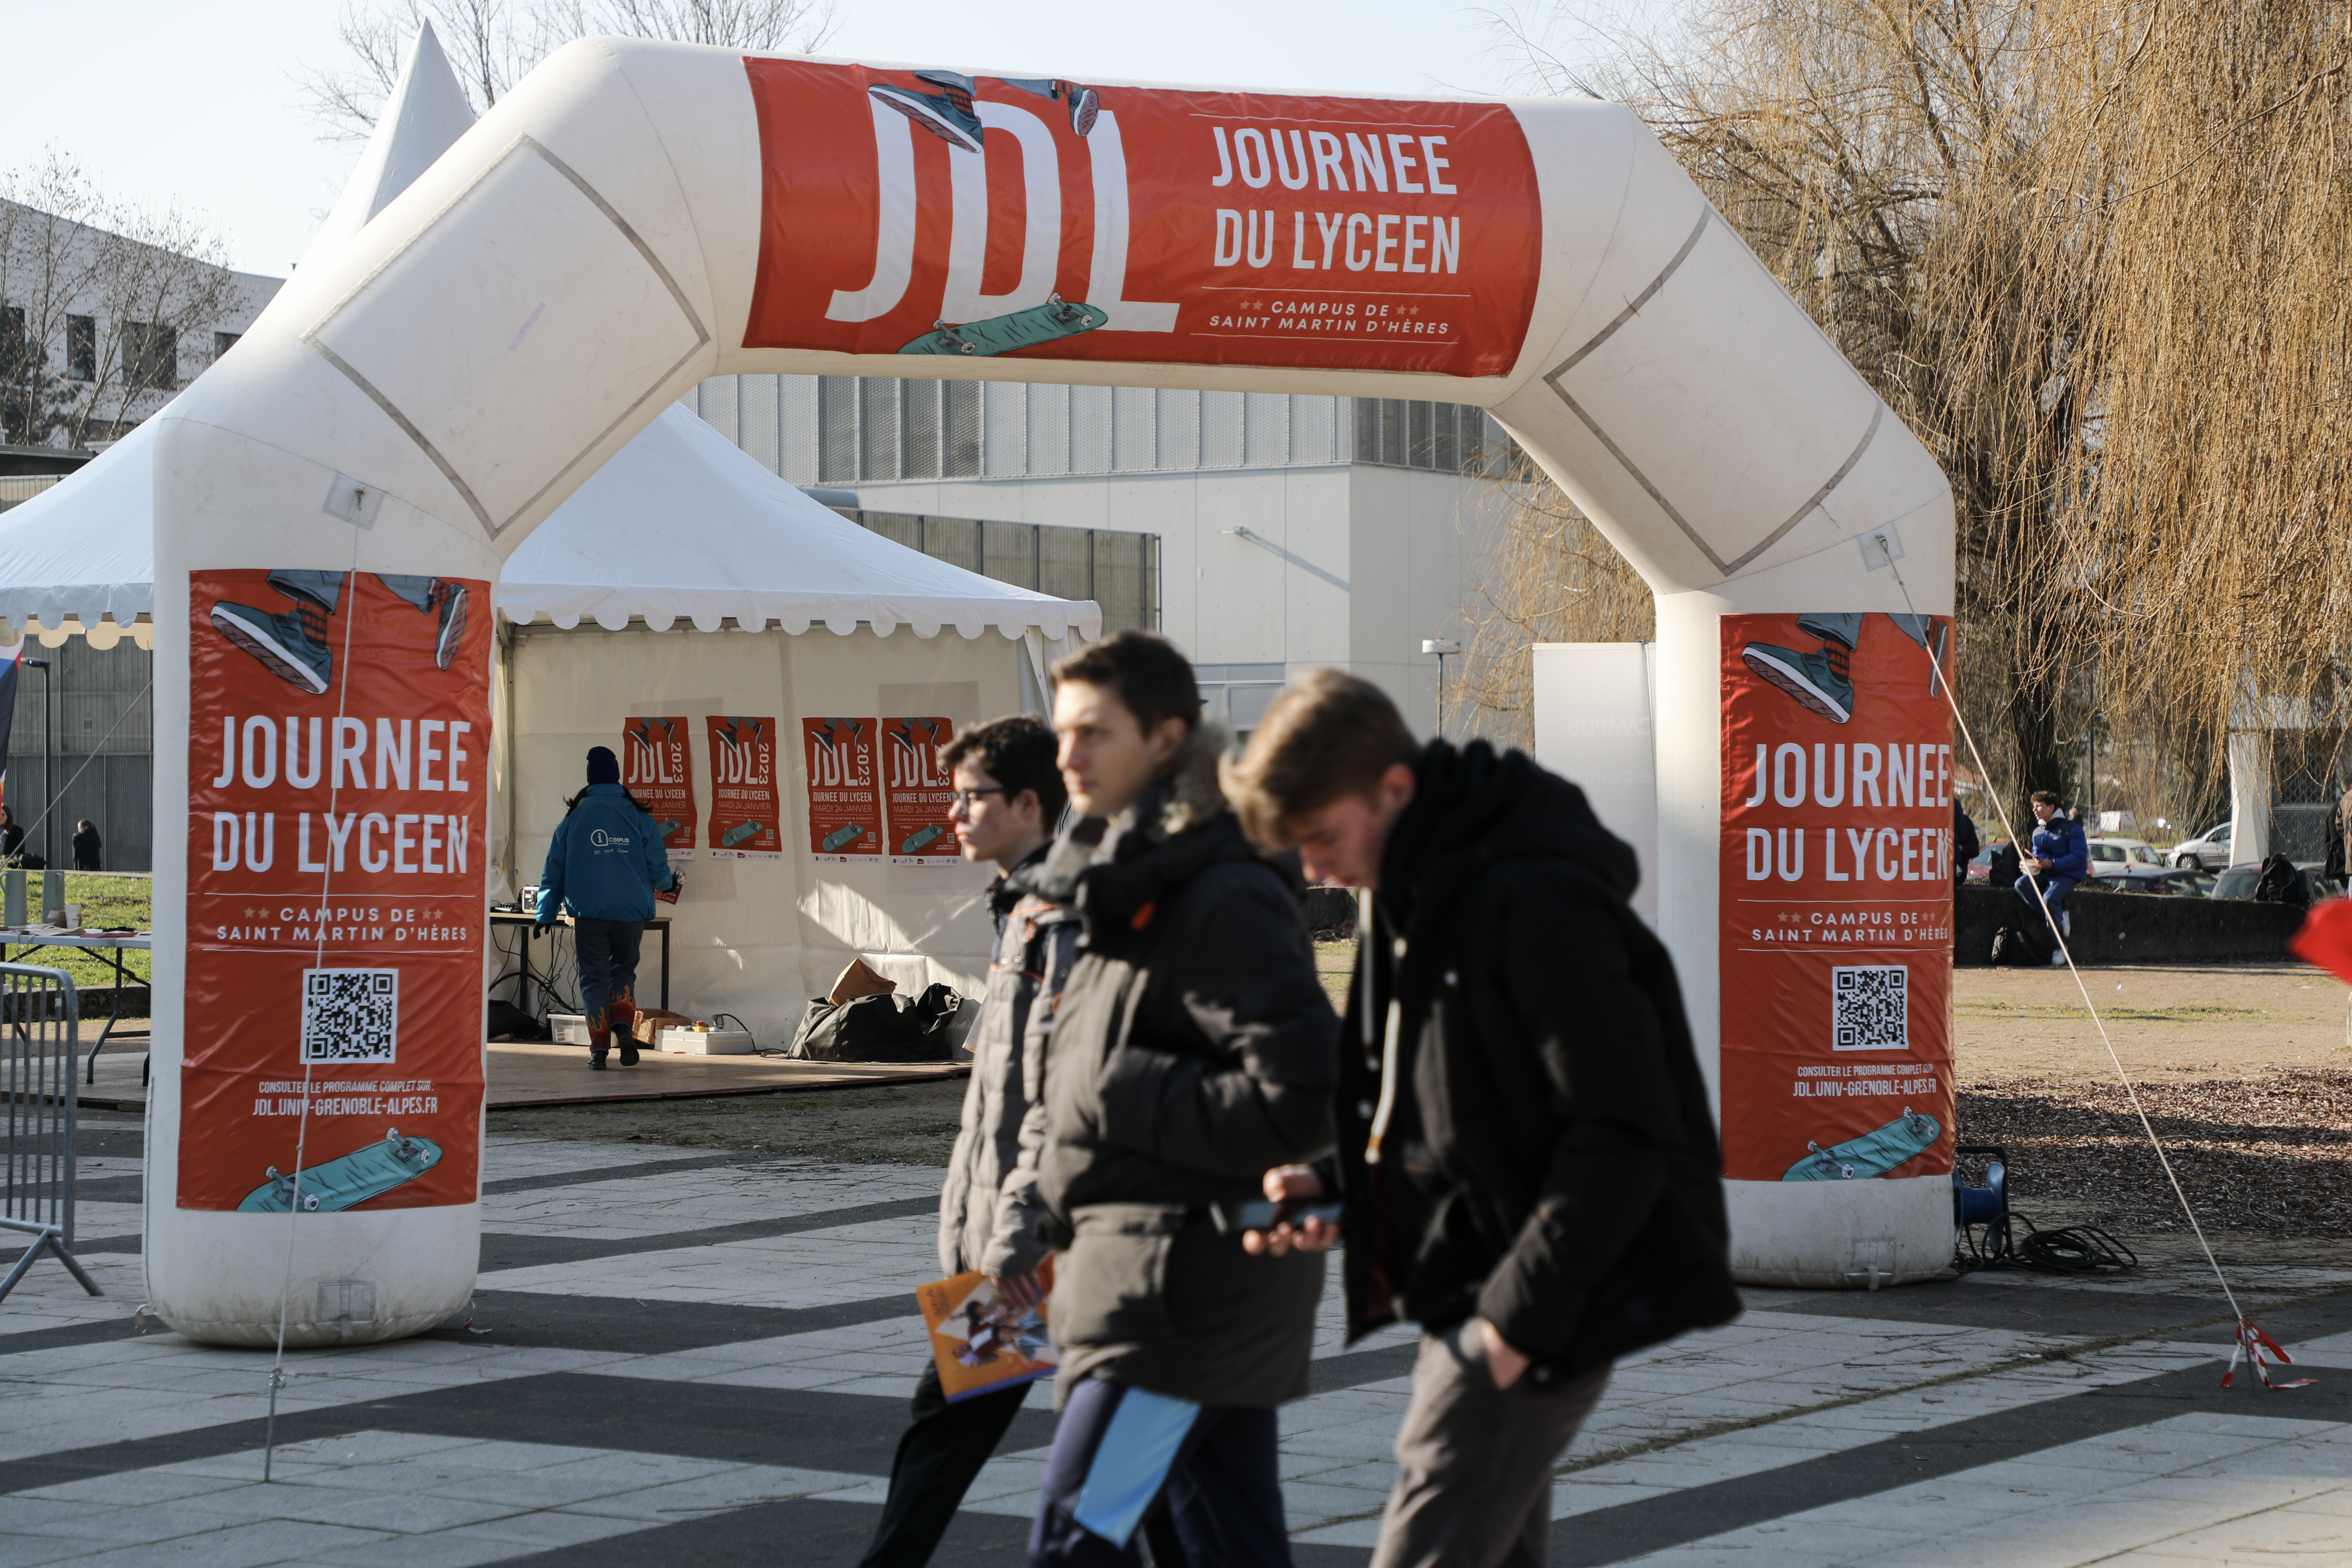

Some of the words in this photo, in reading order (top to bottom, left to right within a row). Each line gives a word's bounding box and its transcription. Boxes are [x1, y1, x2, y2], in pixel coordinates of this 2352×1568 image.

[1212, 125, 1457, 194] JOURNEE
[824, 93, 1180, 333] JDL
[1214, 209, 1274, 268] DU
[1292, 212, 1459, 273] LYCEEN
[1210, 316, 1270, 328] SAINT
[1279, 315, 1356, 331] MARTIN
[1272, 301, 1355, 315] CAMPUS
[1365, 305, 1389, 316] DE
[211, 713, 473, 793] JOURNEE
[628, 741, 673, 783] JDL
[671, 742, 683, 783] 2023
[718, 741, 759, 784] JDL
[759, 743, 769, 785] 2023
[812, 742, 858, 787] JDL
[857, 744, 871, 786] 2023
[892, 743, 937, 787] JDL
[1745, 743, 1950, 807] JOURNEE
[655, 789, 663, 799] DU
[664, 789, 686, 799] LYCEEN
[718, 789, 740, 799] JOURNEE
[741, 789, 748, 799] DU
[749, 790, 770, 800] LYCEEN
[813, 792, 838, 802] JOURNEE
[840, 792, 847, 802] DU
[850, 792, 872, 802] LYCEEN
[893, 793, 917, 803] JOURNEE
[919, 793, 927, 803] DU
[929, 793, 951, 803] LYCEEN
[210, 812, 274, 872] DU
[296, 810, 469, 875] LYCEEN
[1746, 828, 1804, 881] DU
[1826, 827, 1950, 881] LYCEEN
[278, 906, 381, 923] CAMPUS
[391, 909, 415, 922] DE
[1811, 912, 1892, 925] CAMPUS
[1901, 912, 1917, 924] DE
[215, 926, 281, 940] SAINT
[291, 925, 386, 941] MARTIN
[1752, 929, 1812, 941] SAINT
[1822, 929, 1895, 941] MARTIN
[1798, 1066, 1841, 1077] CONSULTER
[1843, 1066, 1851, 1076] LE
[1853, 1065, 1896, 1076] PROGRAMME
[1897, 1064, 1923, 1074] COMPLET
[311, 1082, 321, 1093] LE
[323, 1081, 378, 1092] PROGRAMME
[380, 1080, 418, 1092] COMPLET
[1793, 1078, 1936, 1097] JDL.UNIV-GRENOBLE-ALPES.FR
[251, 1095, 440, 1117] JDL.UNIV-GRENOBLE-ALPES.FR
